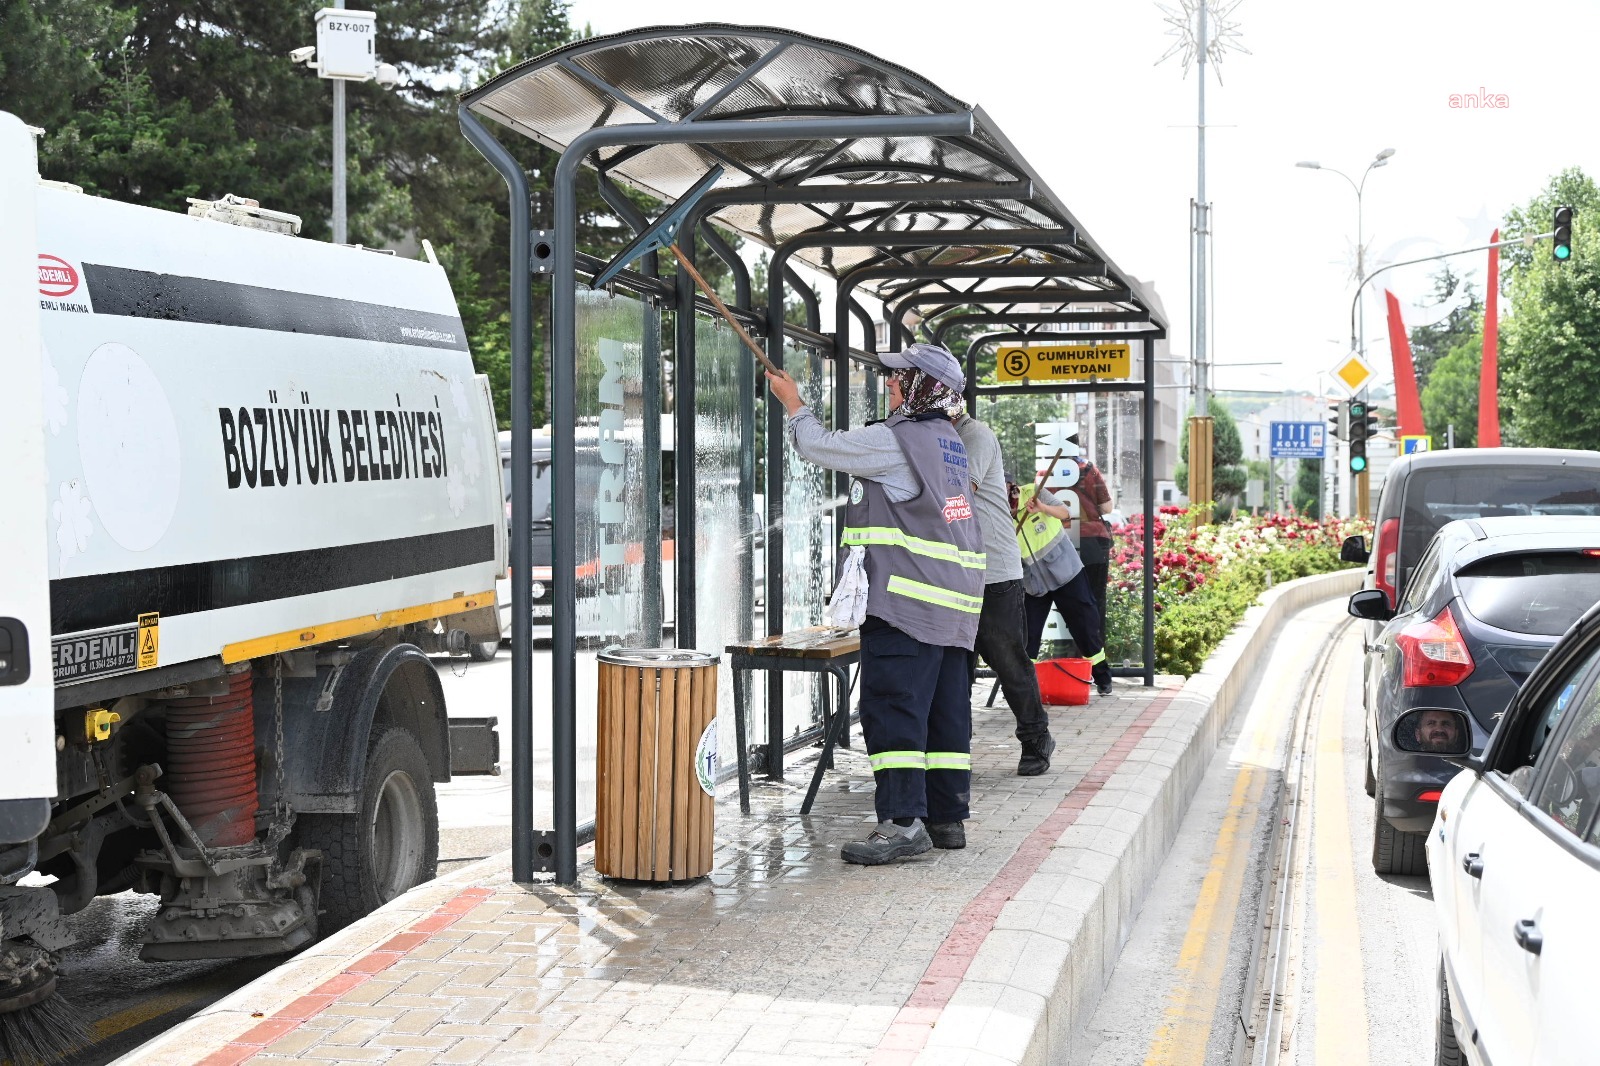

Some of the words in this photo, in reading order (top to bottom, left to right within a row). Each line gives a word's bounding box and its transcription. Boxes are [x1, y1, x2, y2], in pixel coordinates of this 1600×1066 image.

[329, 22, 370, 33] BZY-007
[1037, 347, 1125, 361] CUMHURİYET
[1010, 355, 1024, 372] 5
[1051, 363, 1111, 375] MEYDANI
[218, 389, 337, 489] BOZÜYÜK
[337, 392, 448, 483] BELEDİYESİ
[54, 664, 78, 678] ORUM
